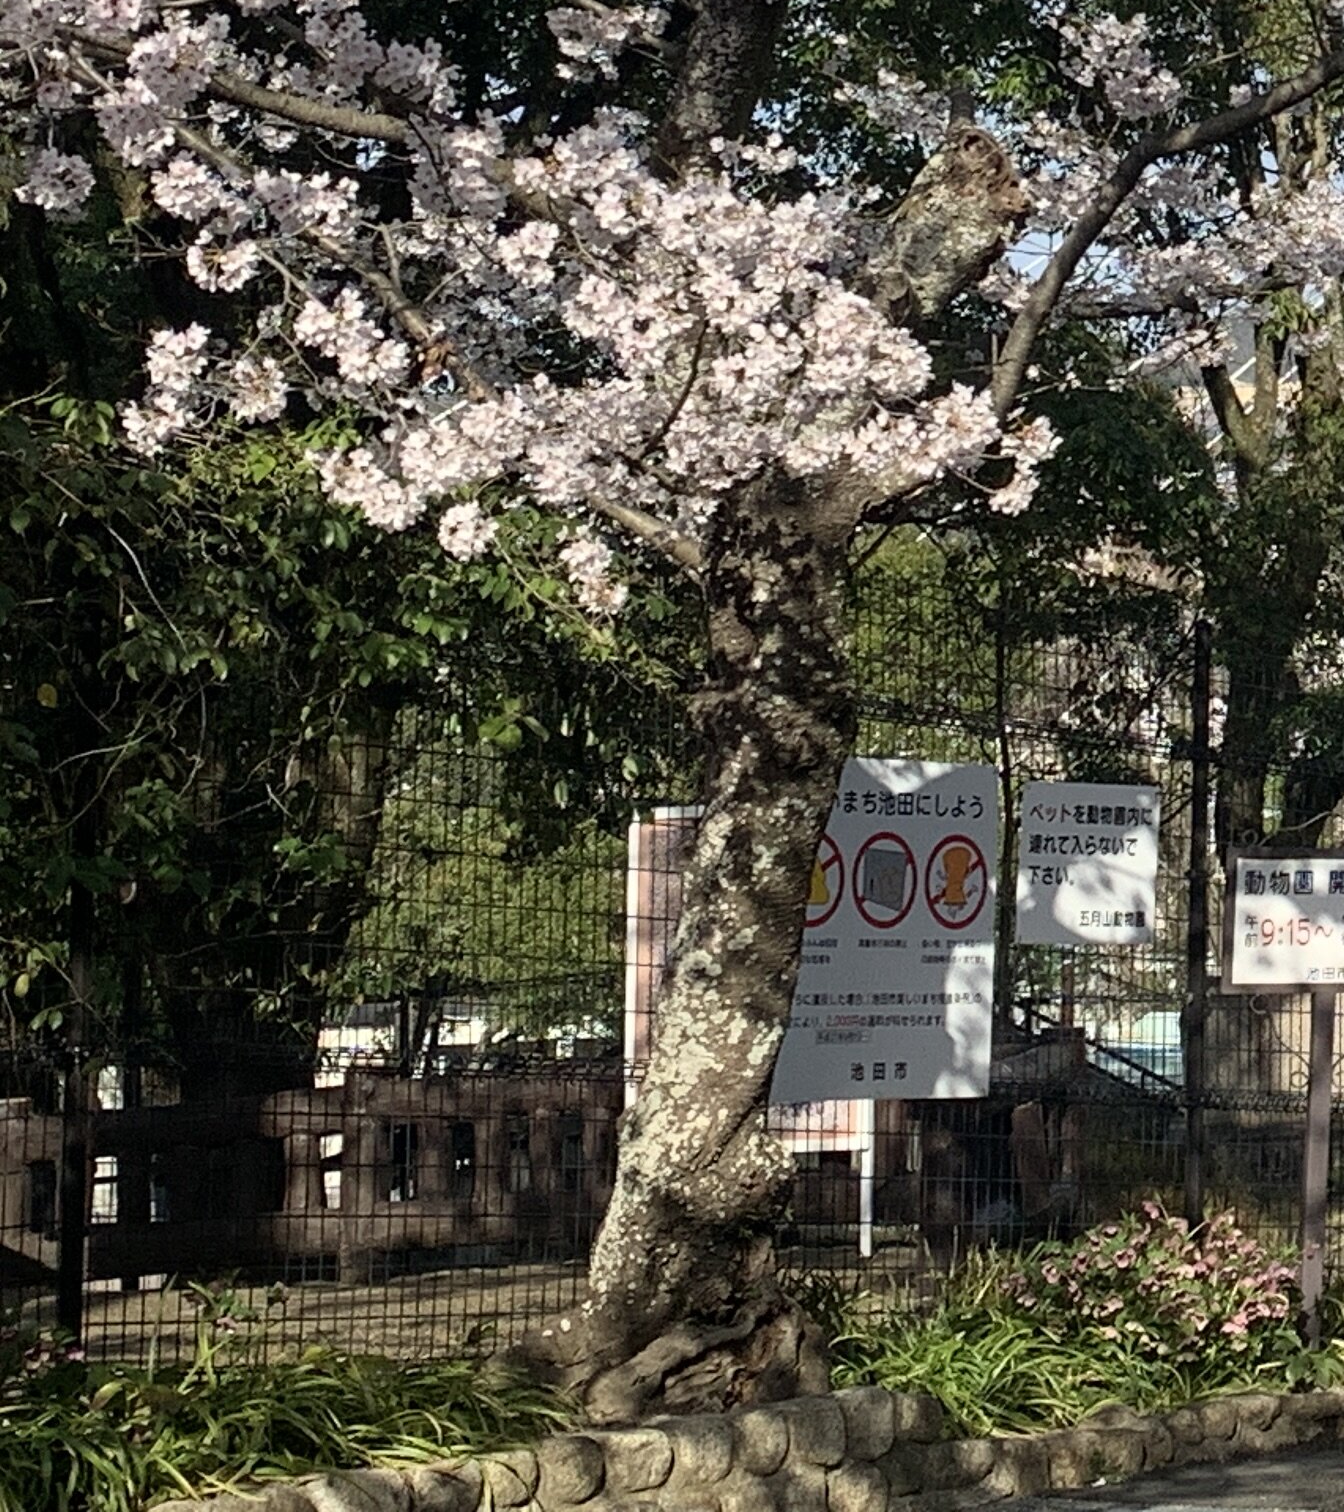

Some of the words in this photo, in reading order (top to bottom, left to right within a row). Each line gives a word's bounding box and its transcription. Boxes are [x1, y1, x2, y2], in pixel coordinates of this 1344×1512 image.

[1029, 803, 1153, 826] ペットを動物園内に
[1028, 864, 1075, 886] 下さい。
[1244, 869, 1314, 895] 動物園
[1079, 910, 1146, 928] 五月山動物園
